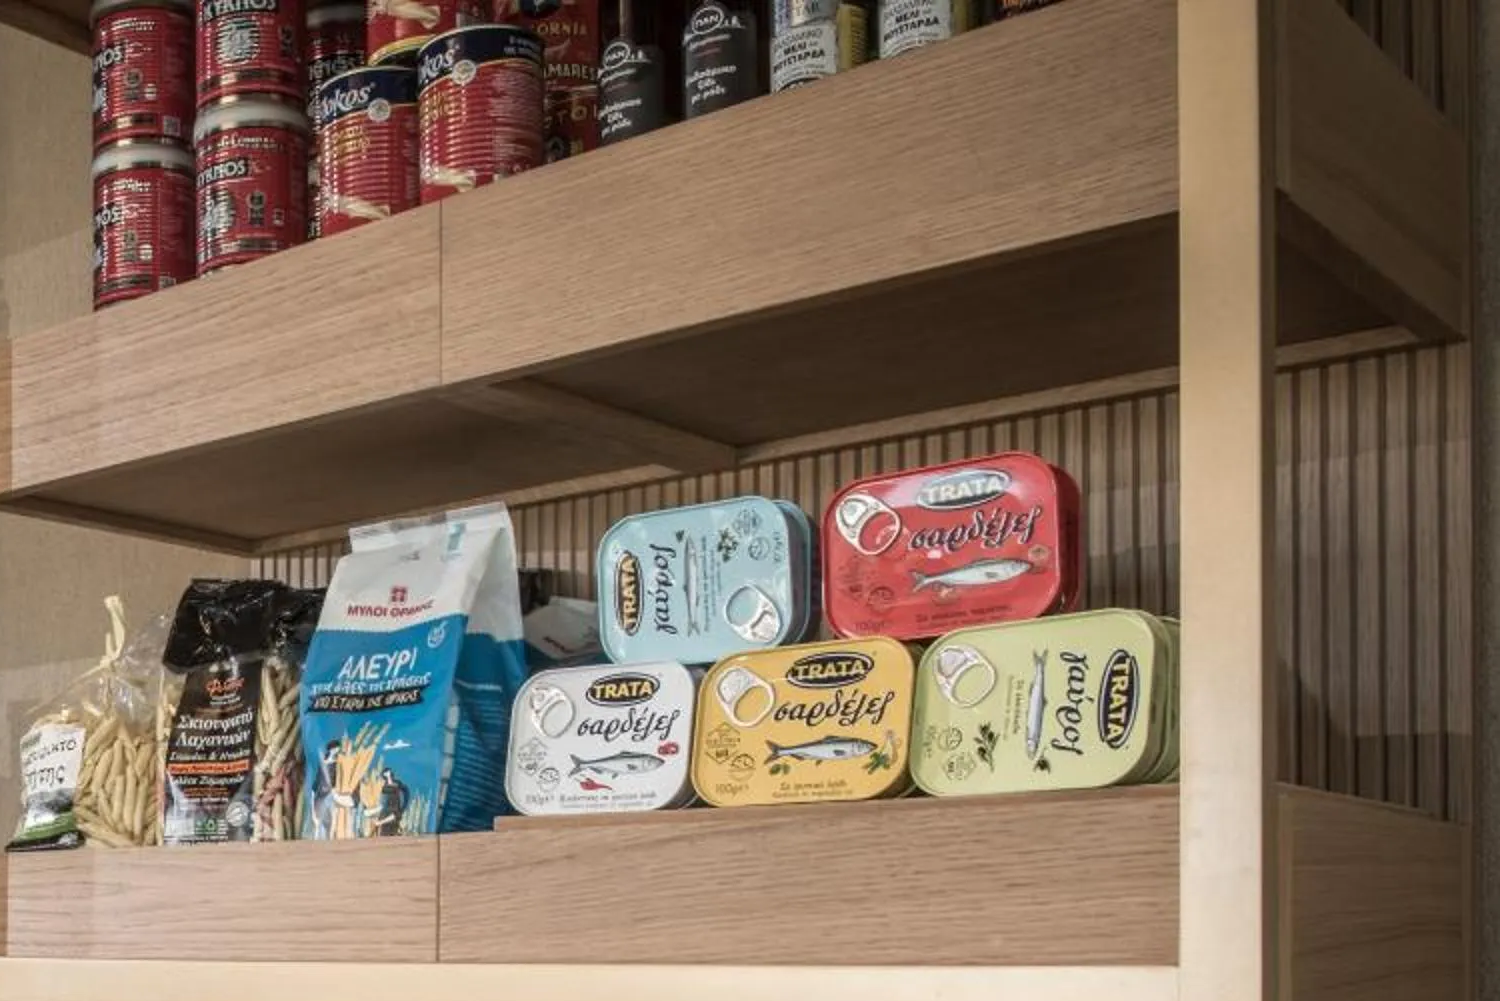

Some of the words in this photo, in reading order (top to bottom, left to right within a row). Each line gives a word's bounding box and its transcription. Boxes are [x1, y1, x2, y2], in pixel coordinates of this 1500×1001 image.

[925, 477, 1003, 504] TRATA
[621, 558, 638, 630] TRATA
[337, 647, 418, 681] ΑΛΕΥΡΙ
[795, 659, 866, 680] TRATA
[593, 680, 654, 700] TRATA
[1106, 657, 1131, 744] TRATA
